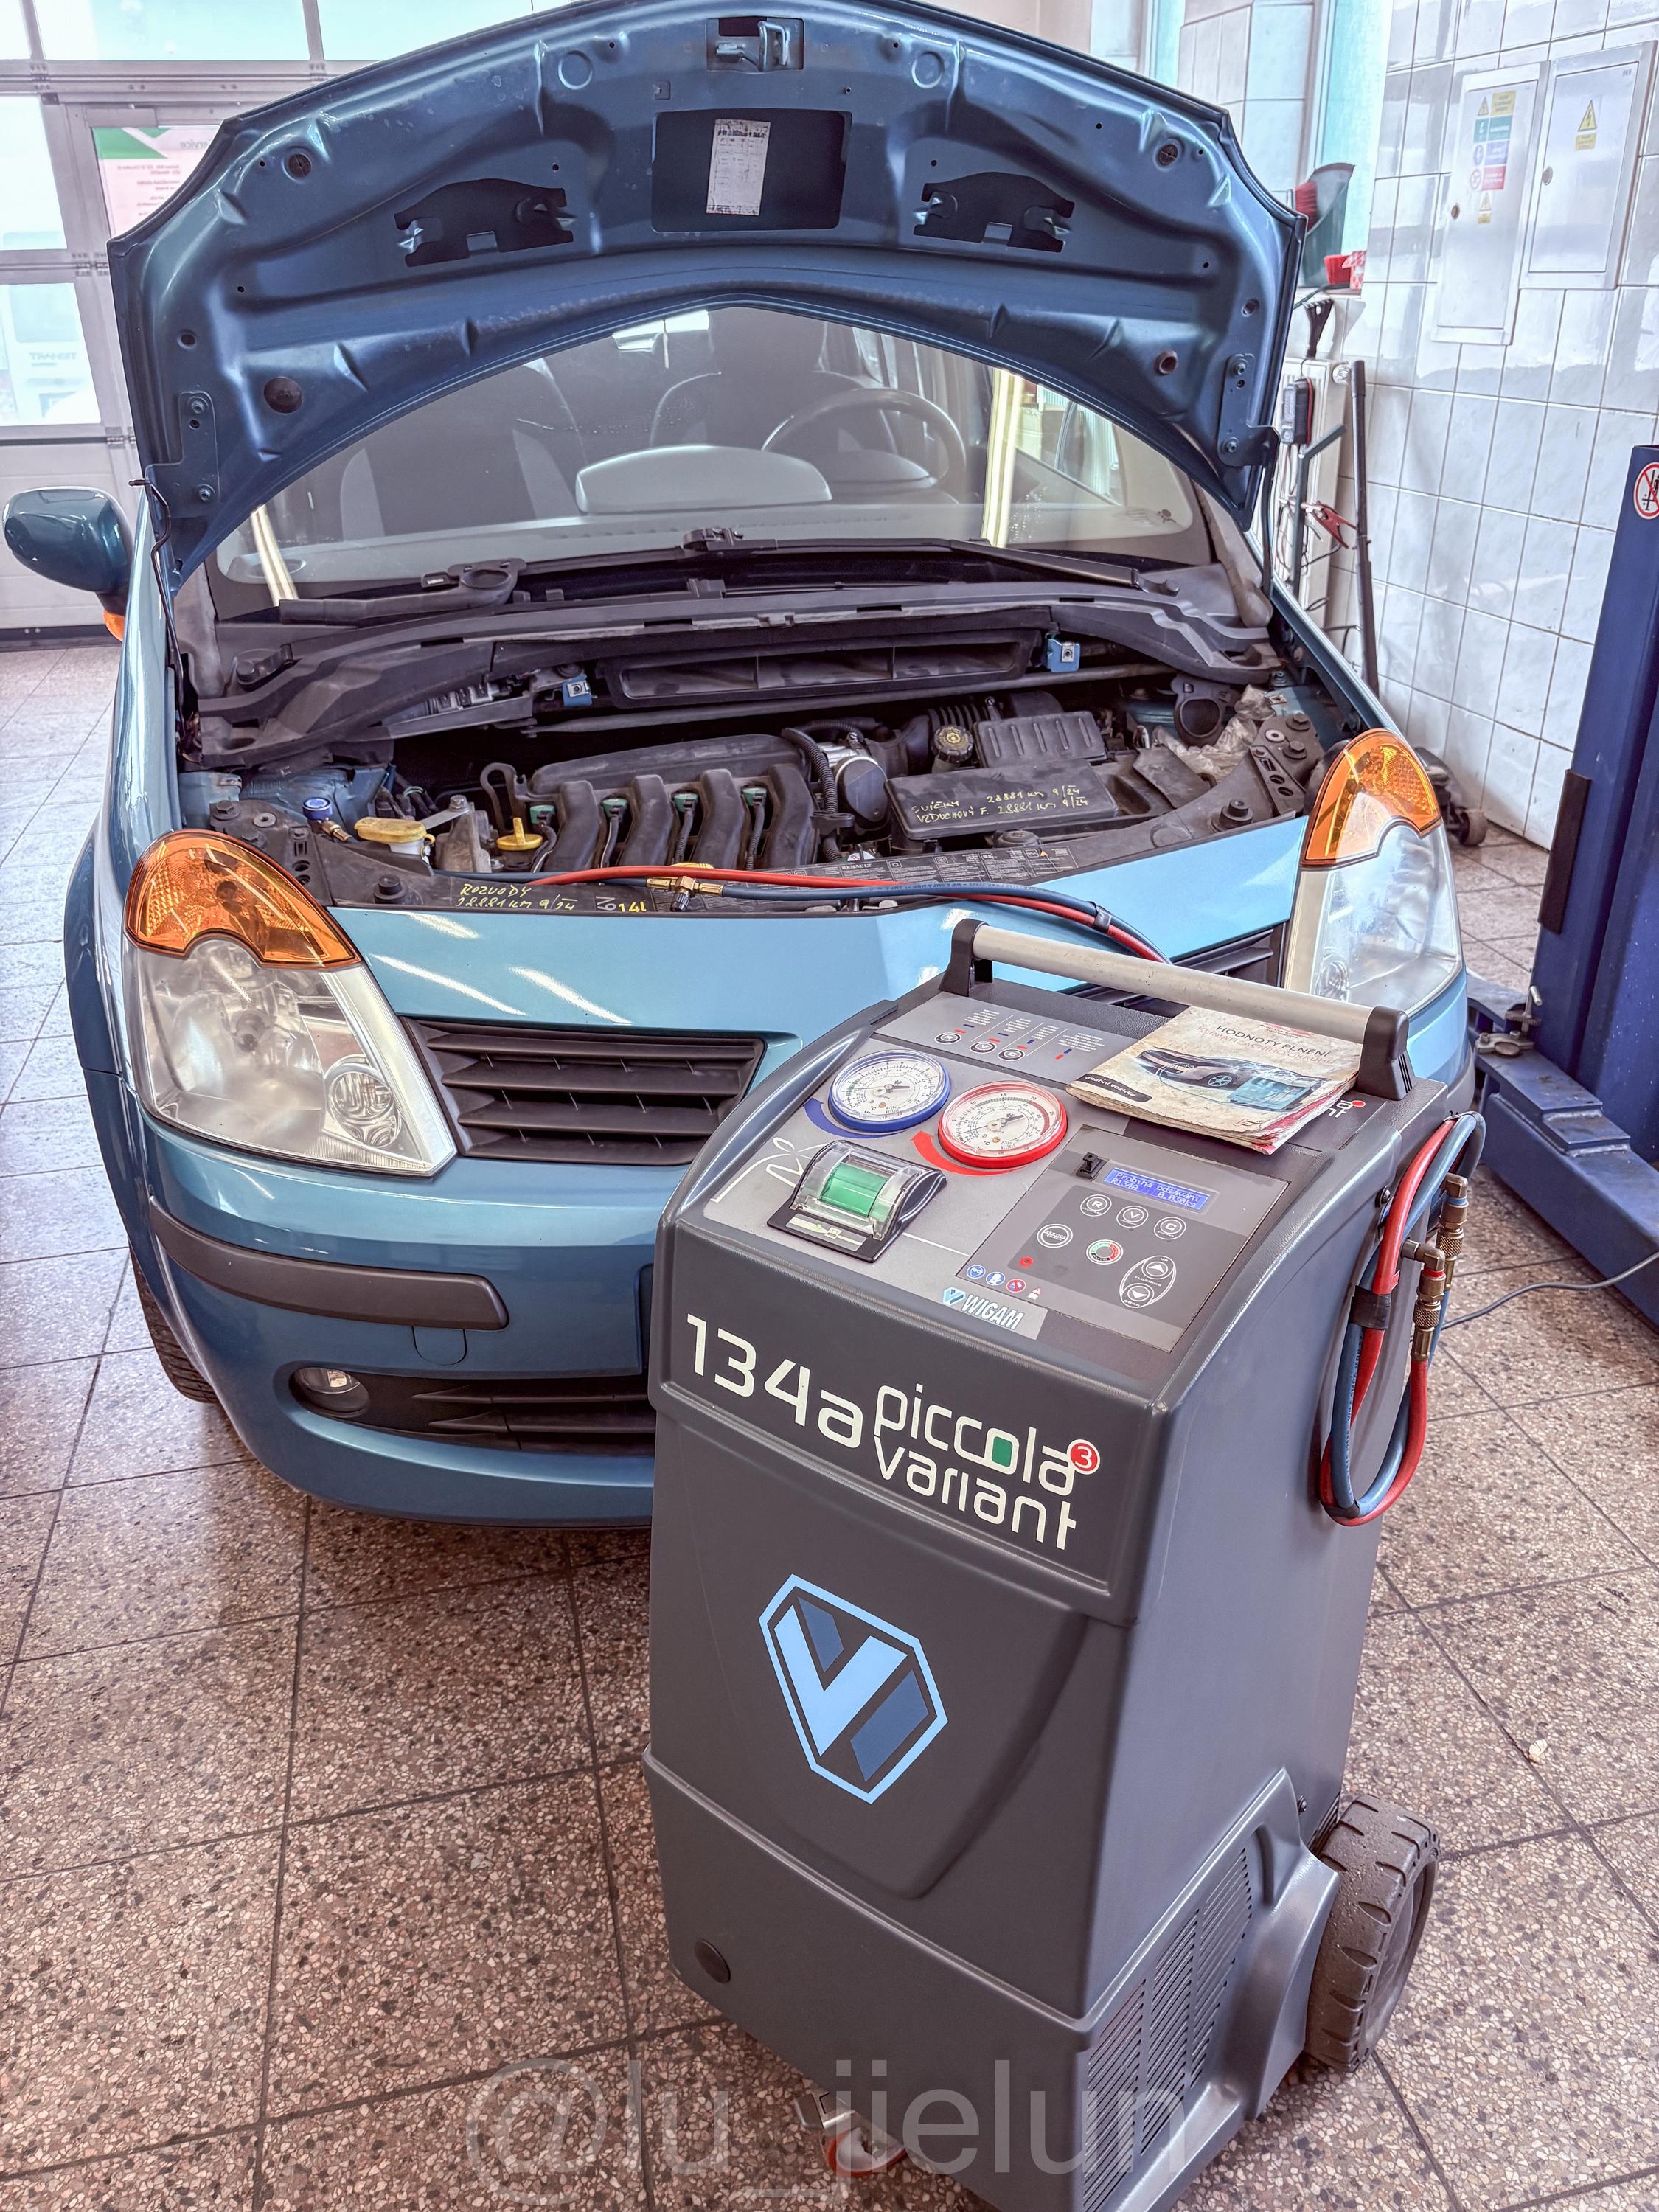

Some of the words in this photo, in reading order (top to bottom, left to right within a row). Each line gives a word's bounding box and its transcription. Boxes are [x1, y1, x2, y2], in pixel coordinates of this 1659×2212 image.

[459, 884, 532, 898] ROZVODY
[1215, 1025, 1282, 1046] HODNOTY
[1110, 1178, 1139, 1192] R134A
[1091, 1200, 1103, 1208] R
[1130, 1211, 1141, 1219] V
[1165, 1222, 1177, 1231] C
[961, 1294, 1025, 1330] WIGAM
[687, 1314, 863, 1448] 134a
[874, 1383, 1075, 1496] piccola
[1075, 1445, 1093, 1469] 3
[874, 1436, 1077, 1550] variant
